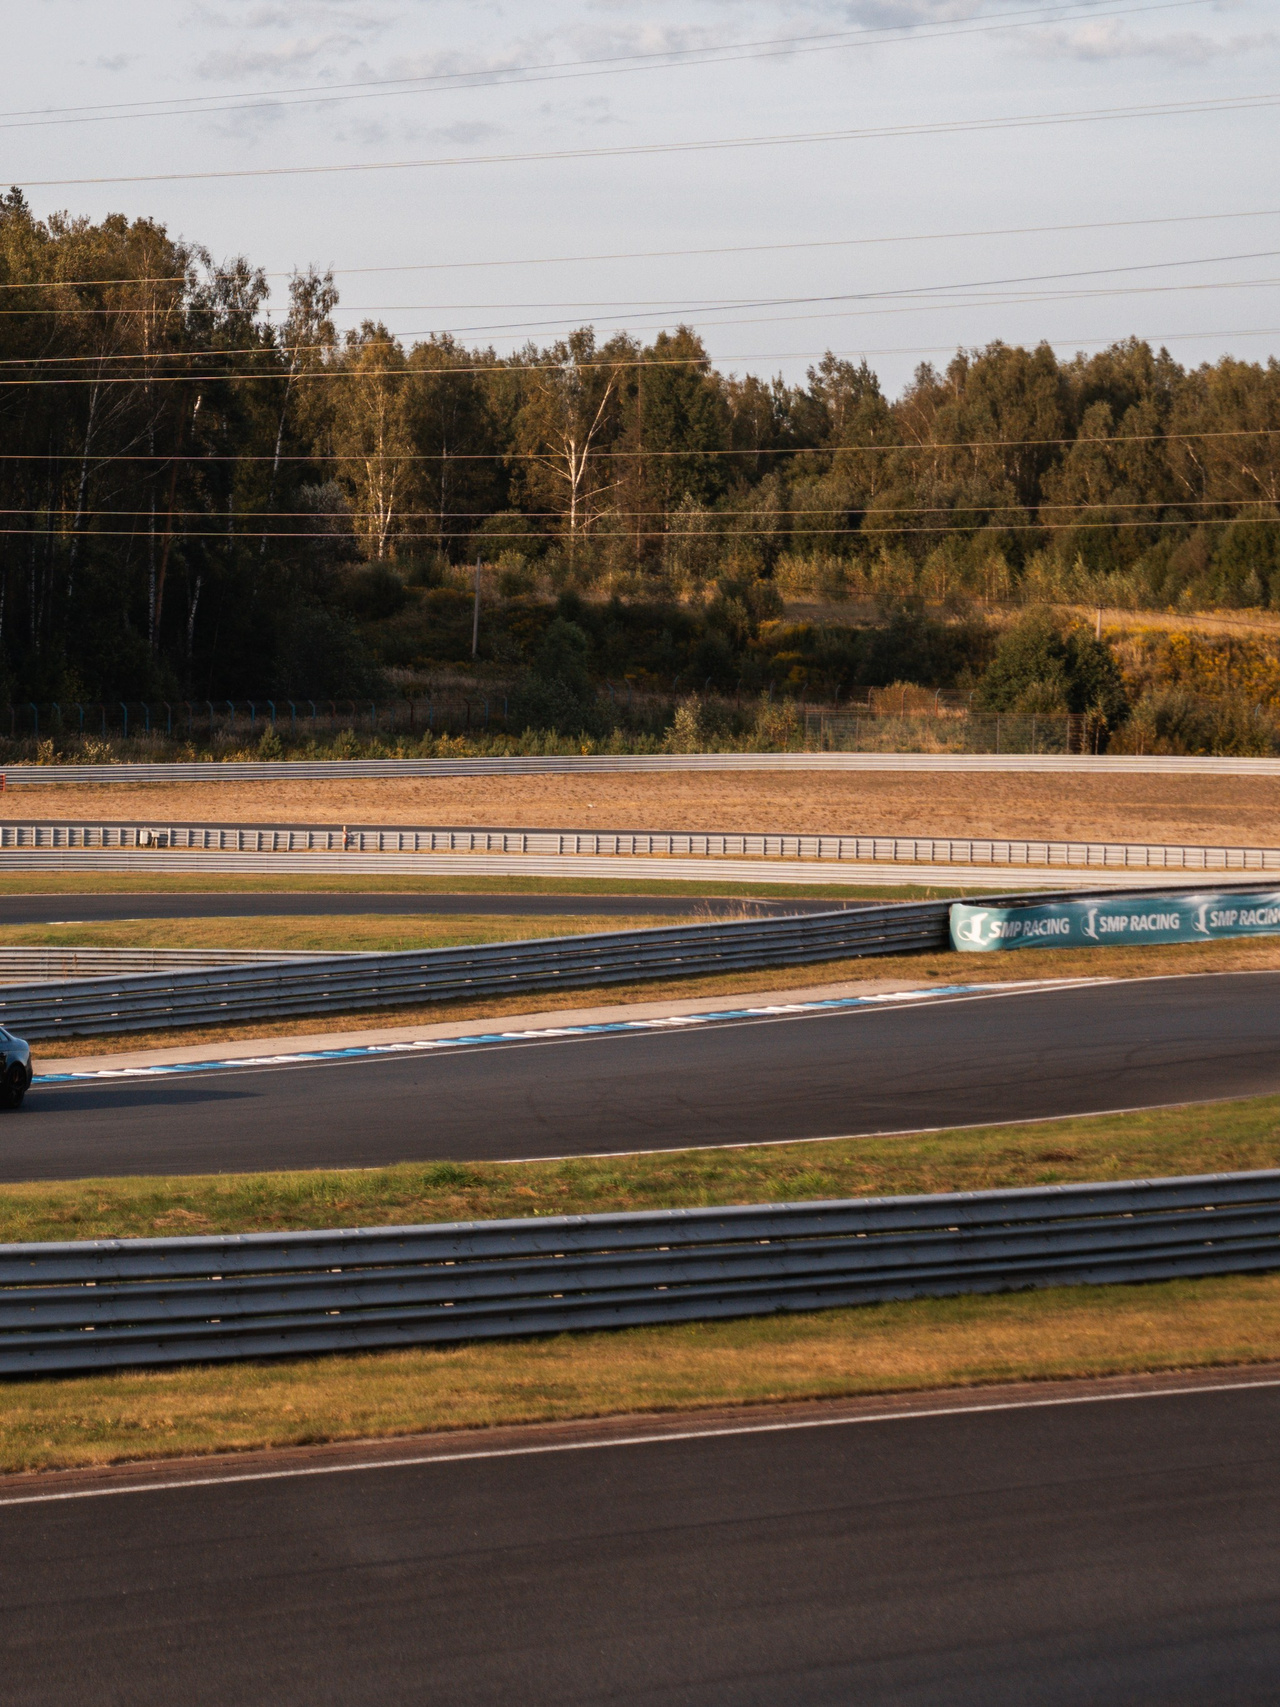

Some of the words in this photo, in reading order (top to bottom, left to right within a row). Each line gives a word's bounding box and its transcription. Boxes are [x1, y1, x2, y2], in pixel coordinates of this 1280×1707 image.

[1099, 915, 1129, 932] SMP
[1130, 913, 1180, 931] RACING
[1210, 910, 1238, 927] SMP
[1239, 907, 1280, 925] RACIN
[988, 921, 1022, 938] SMP
[1023, 918, 1070, 936] RACING
